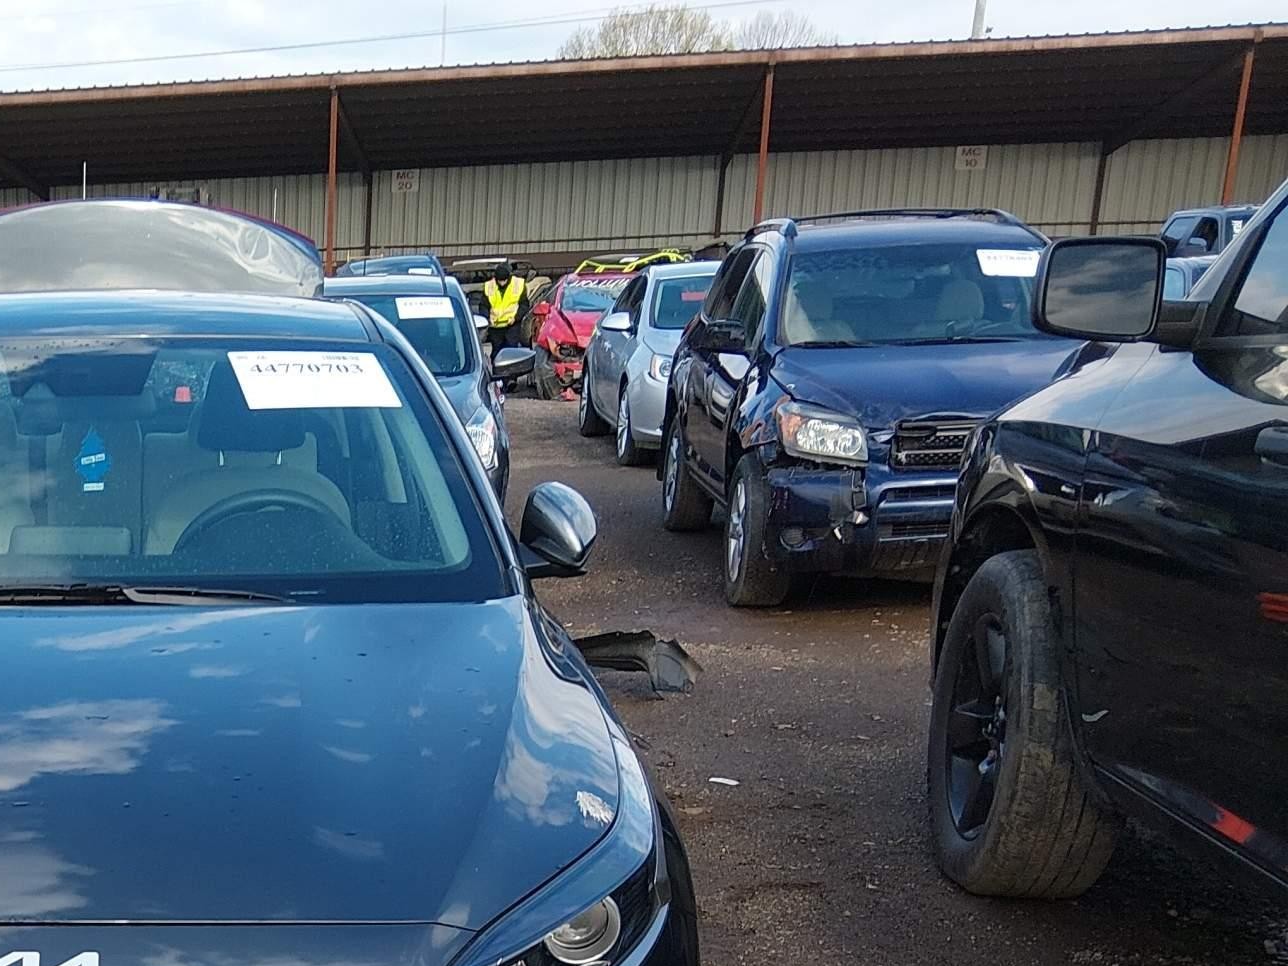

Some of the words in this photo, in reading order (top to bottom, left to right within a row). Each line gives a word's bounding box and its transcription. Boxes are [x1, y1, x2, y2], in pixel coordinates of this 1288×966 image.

[961, 147, 982, 156] MC
[965, 159, 978, 168] 10
[396, 171, 415, 180] MC
[398, 181, 413, 190] 20
[250, 362, 364, 374] 44770703
